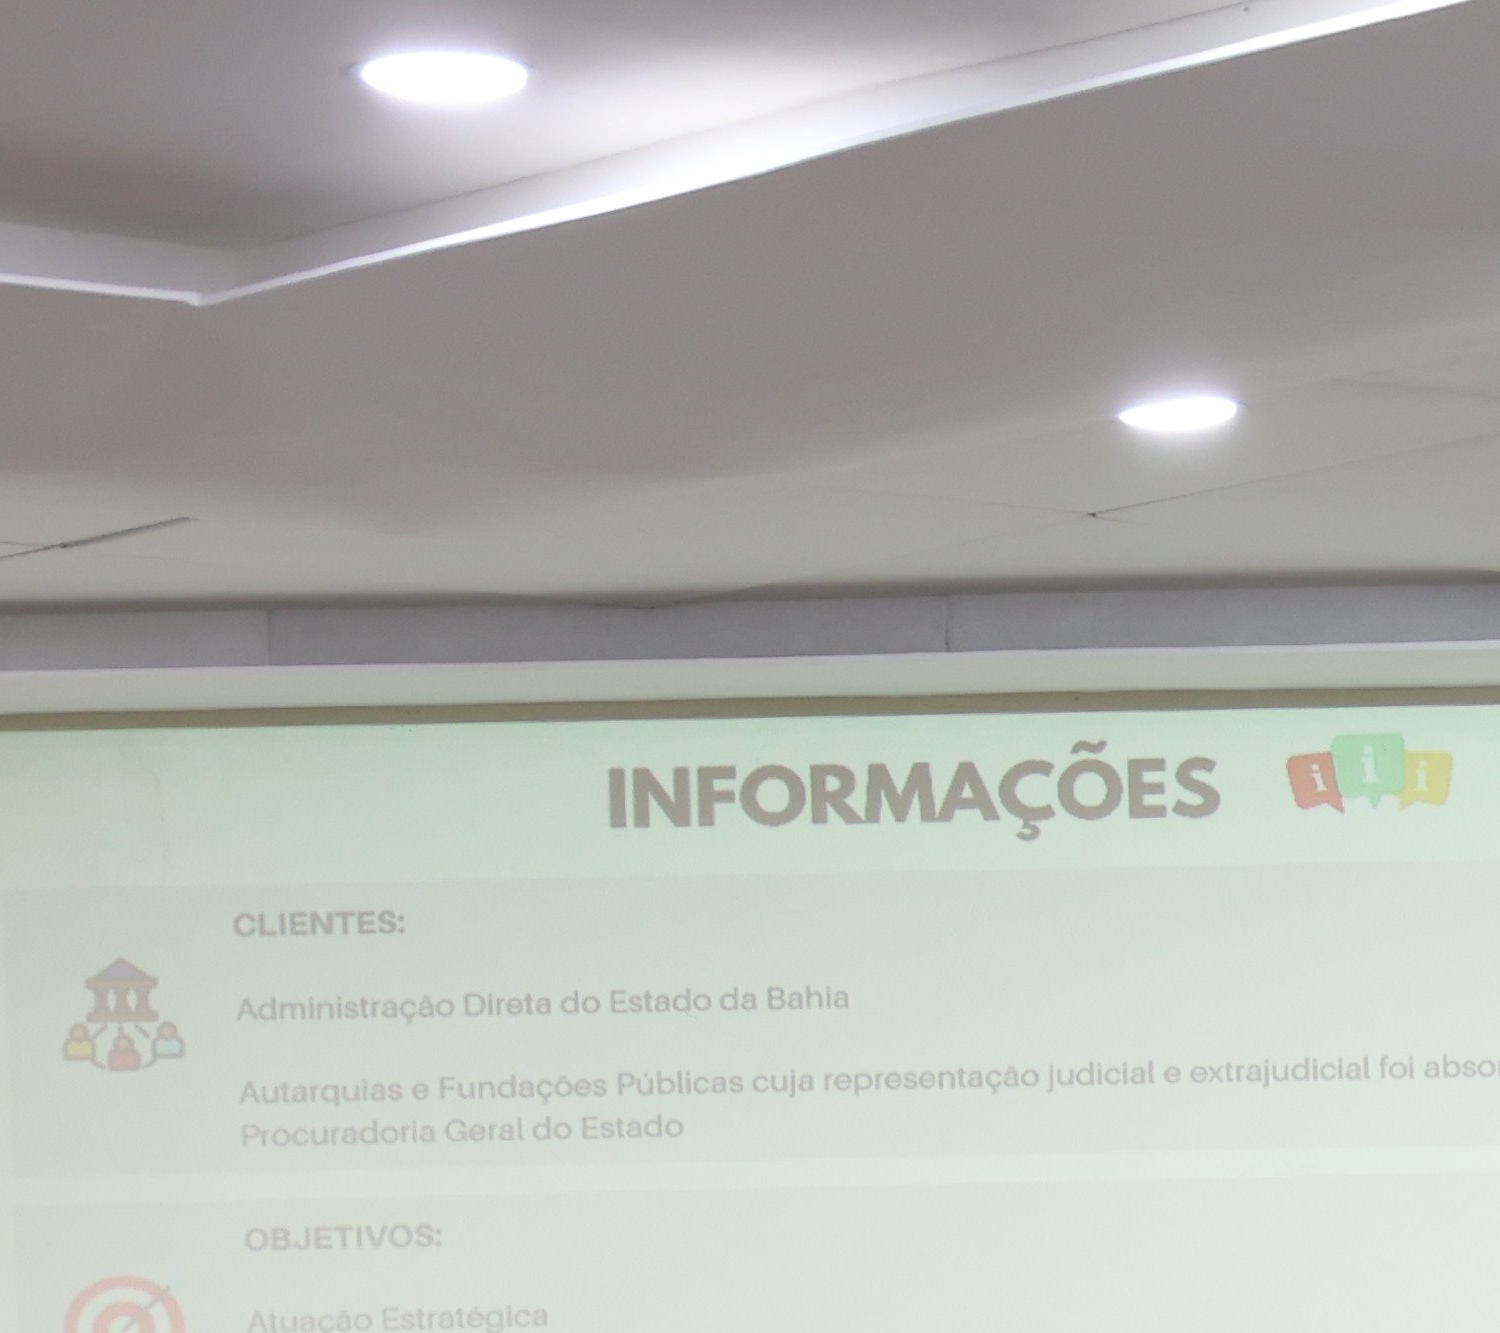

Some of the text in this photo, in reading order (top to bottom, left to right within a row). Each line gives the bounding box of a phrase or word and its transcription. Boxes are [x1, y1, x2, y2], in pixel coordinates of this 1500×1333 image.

[608, 739, 1221, 842] INFORMAÇÕES
[233, 910, 405, 937] CLIENTES:
[237, 984, 849, 1024] Administração Direta do Estado da Bahia
[240, 1078, 403, 1108] Autarquias
[411, 1082, 429, 1101] e
[439, 1073, 607, 1105] Fundações
[617, 1069, 744, 1097] Públicas
[752, 1069, 814, 1099] cuja
[824, 1065, 1040, 1097] representação
[1047, 1059, 1155, 1094] judicial
[1163, 1065, 1181, 1085] e
[1190, 1055, 1371, 1089] extrajudicial
[1379, 1053, 1414, 1080] foi
[241, 1112, 684, 1147] Procuradoria Geral do Estado
[245, 1224, 442, 1251] OBJETIVOS:
